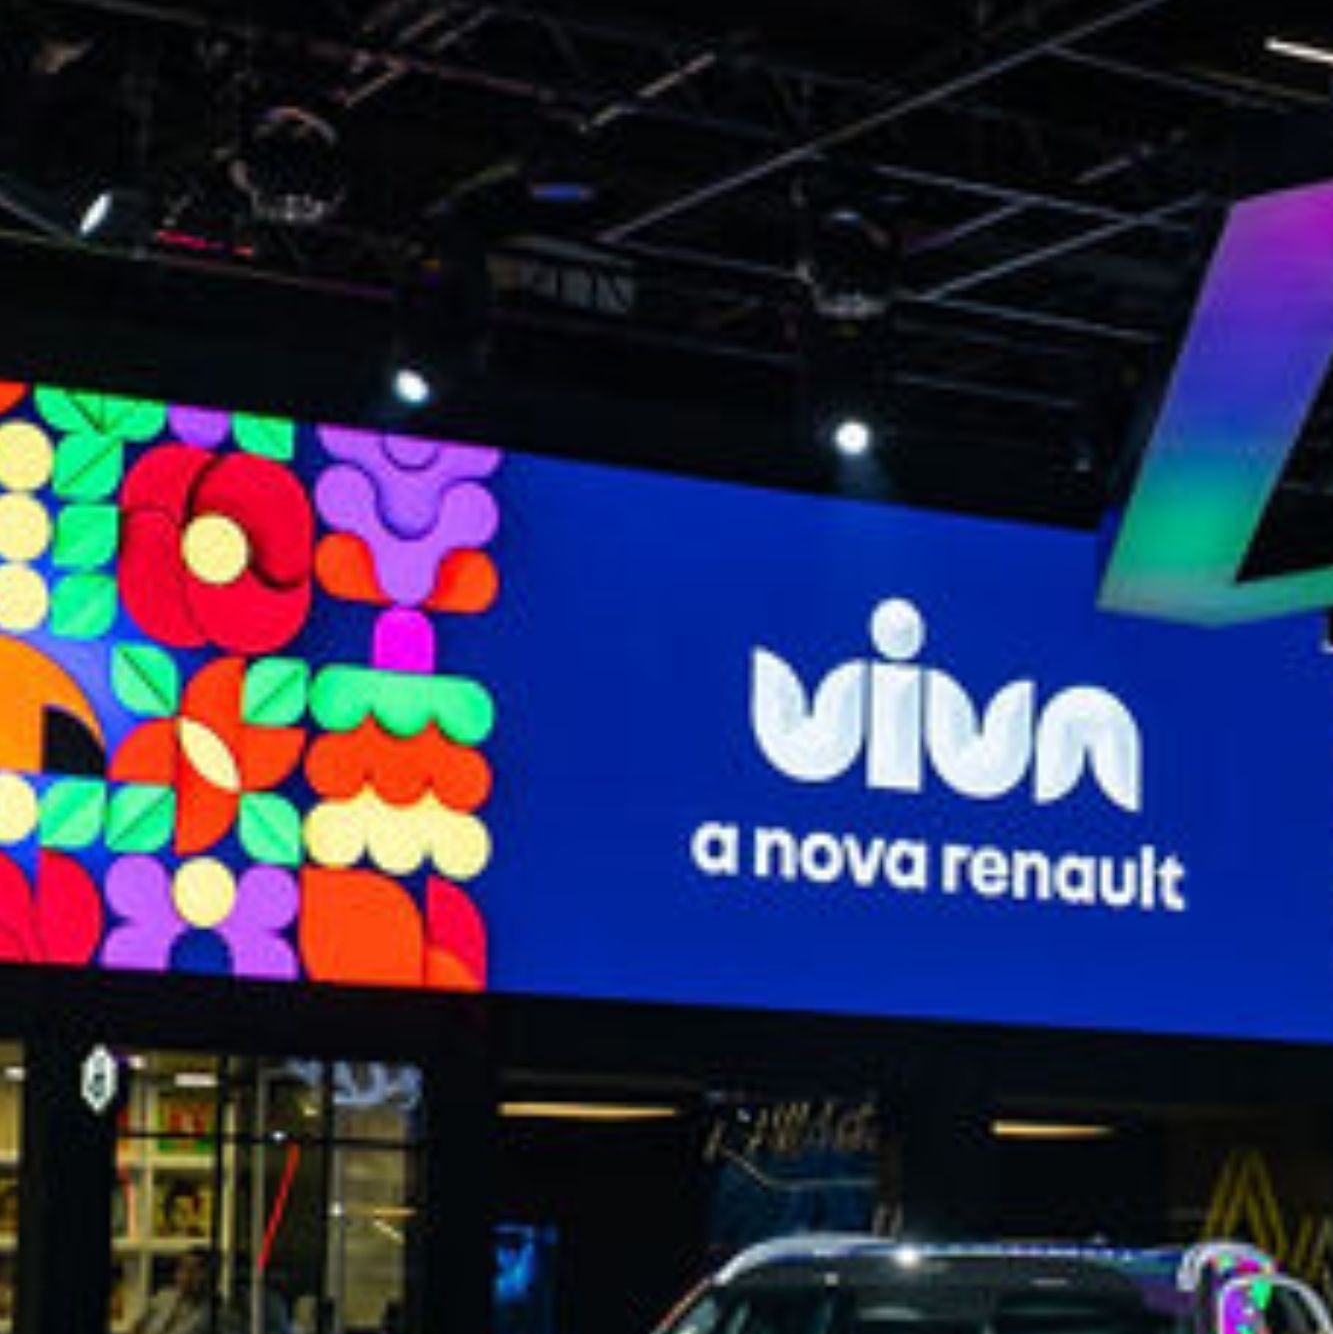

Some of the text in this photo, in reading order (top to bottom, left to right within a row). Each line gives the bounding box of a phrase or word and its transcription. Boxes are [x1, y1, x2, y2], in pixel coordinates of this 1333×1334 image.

[752, 597, 1142, 811] viva
[691, 822, 1185, 911] a nova renault
